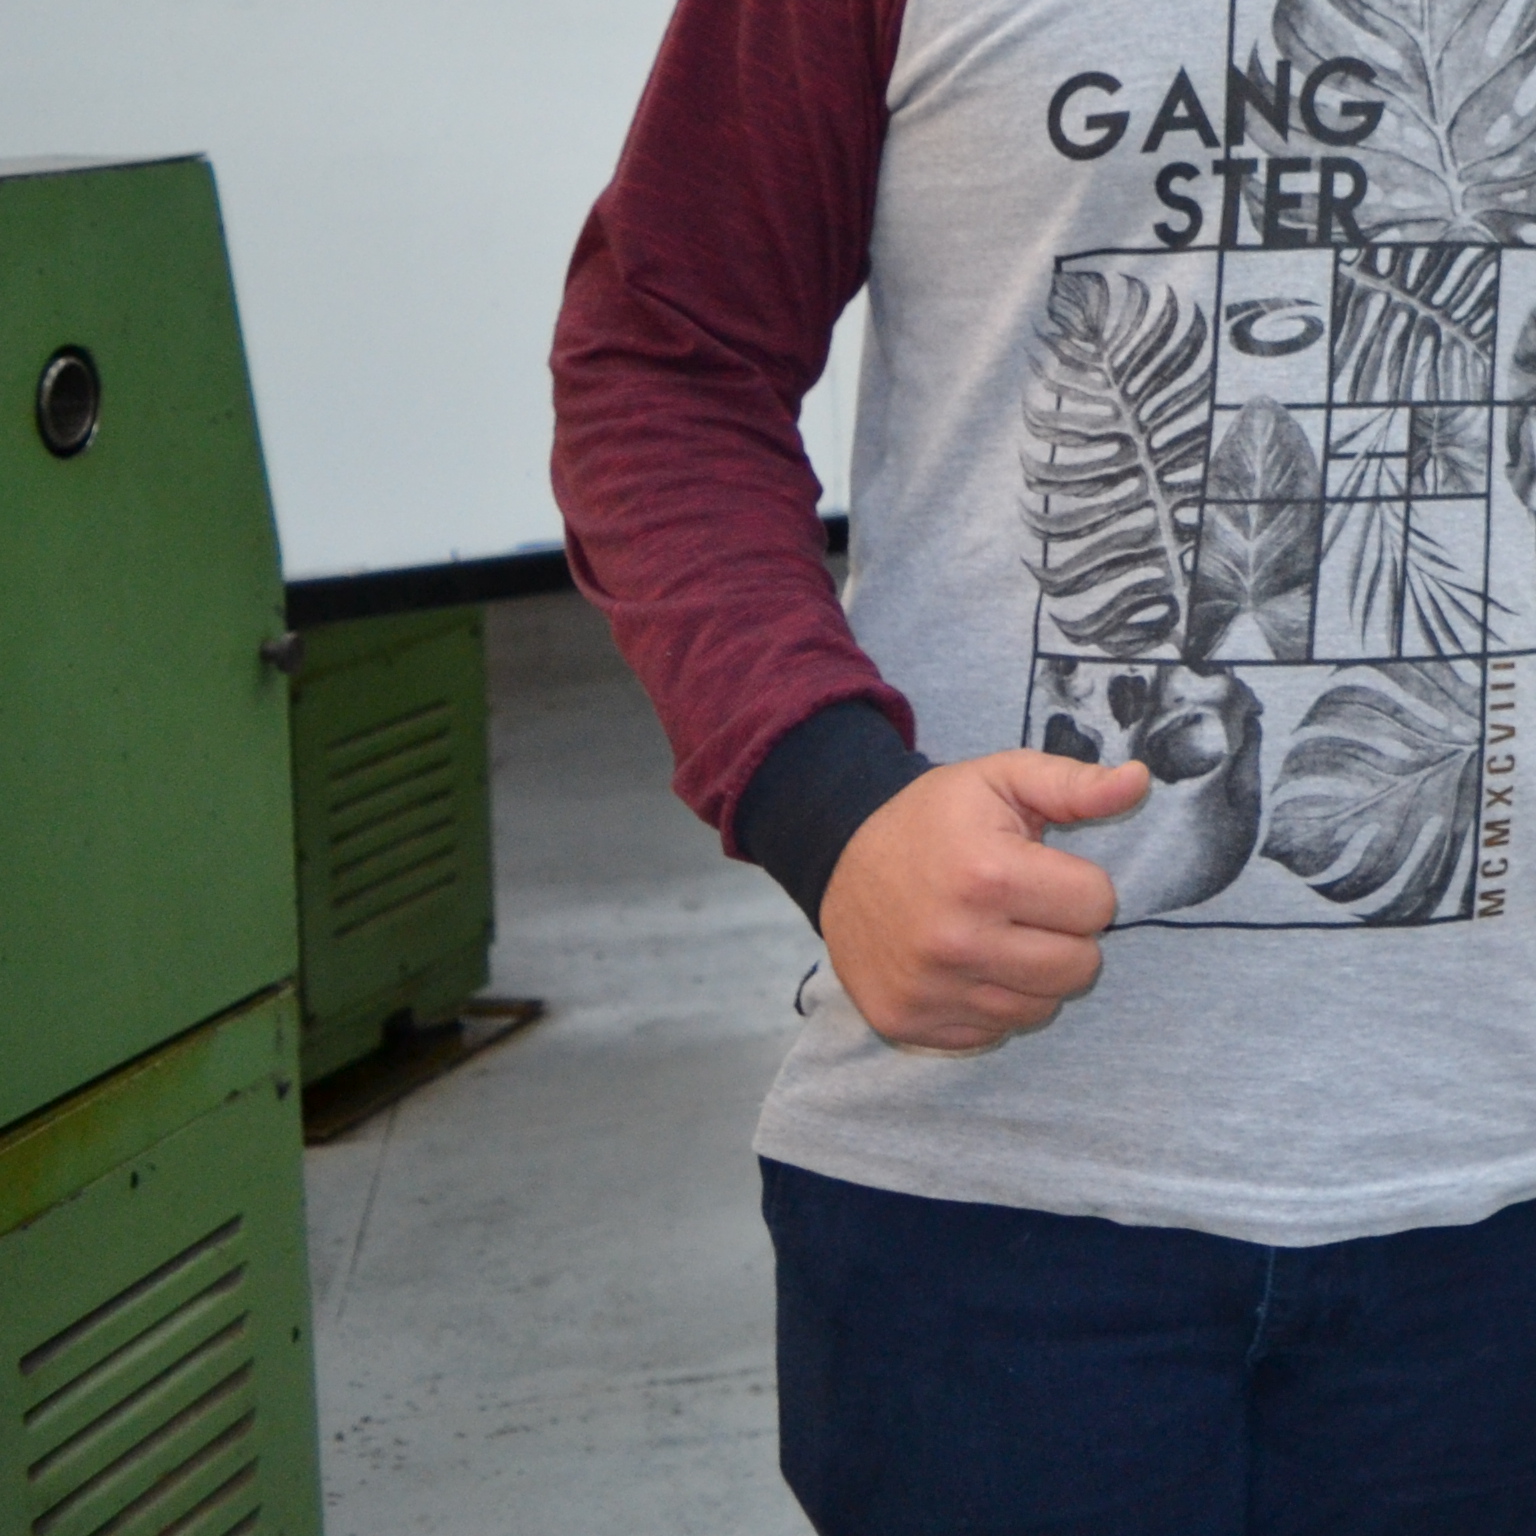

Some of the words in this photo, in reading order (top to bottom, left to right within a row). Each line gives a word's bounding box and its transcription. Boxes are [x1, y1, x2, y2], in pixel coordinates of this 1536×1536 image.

[1046, 56, 1387, 161] GANG
[1153, 156, 1370, 249] STER
[1477, 661, 1516, 919] MCMXCVIII
